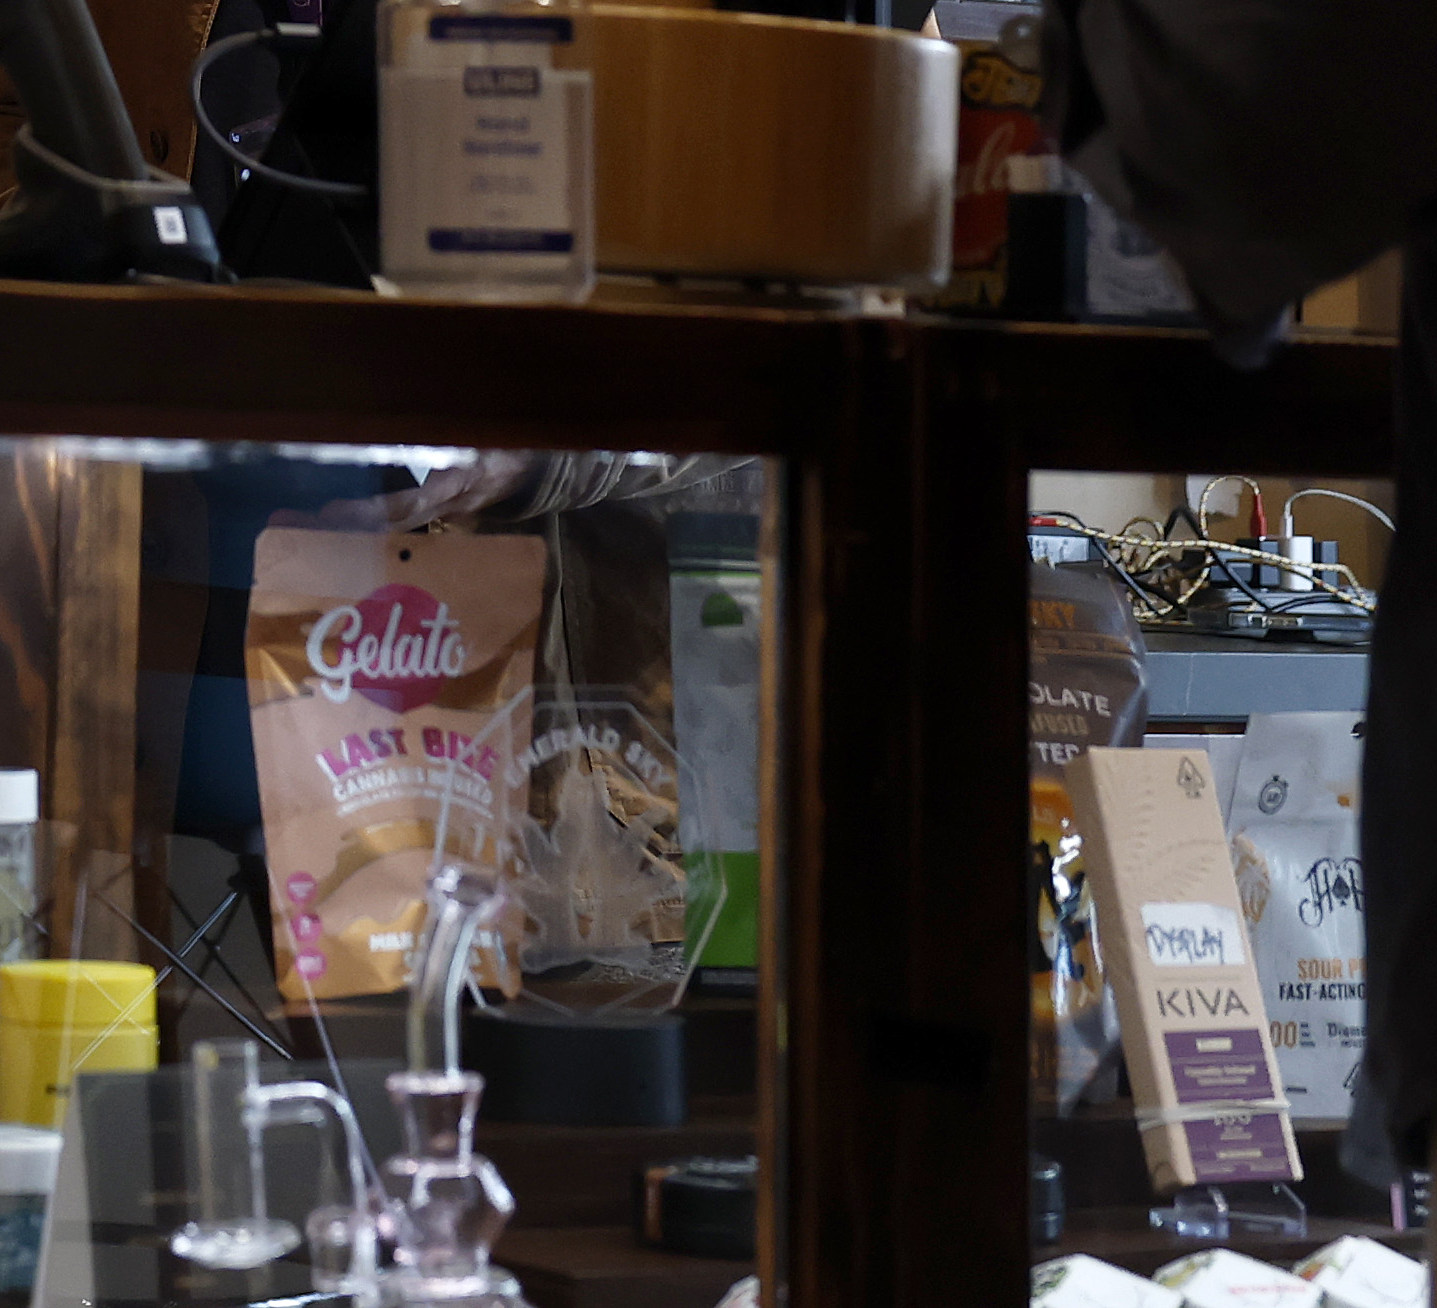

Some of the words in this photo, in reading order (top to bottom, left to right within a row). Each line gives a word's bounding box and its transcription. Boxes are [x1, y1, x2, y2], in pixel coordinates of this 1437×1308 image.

[305, 600, 468, 704] Gelato
[315, 729, 408, 783] LAST
[1297, 958, 1343, 981] SOUR
[1156, 988, 1250, 1017] KIVA
